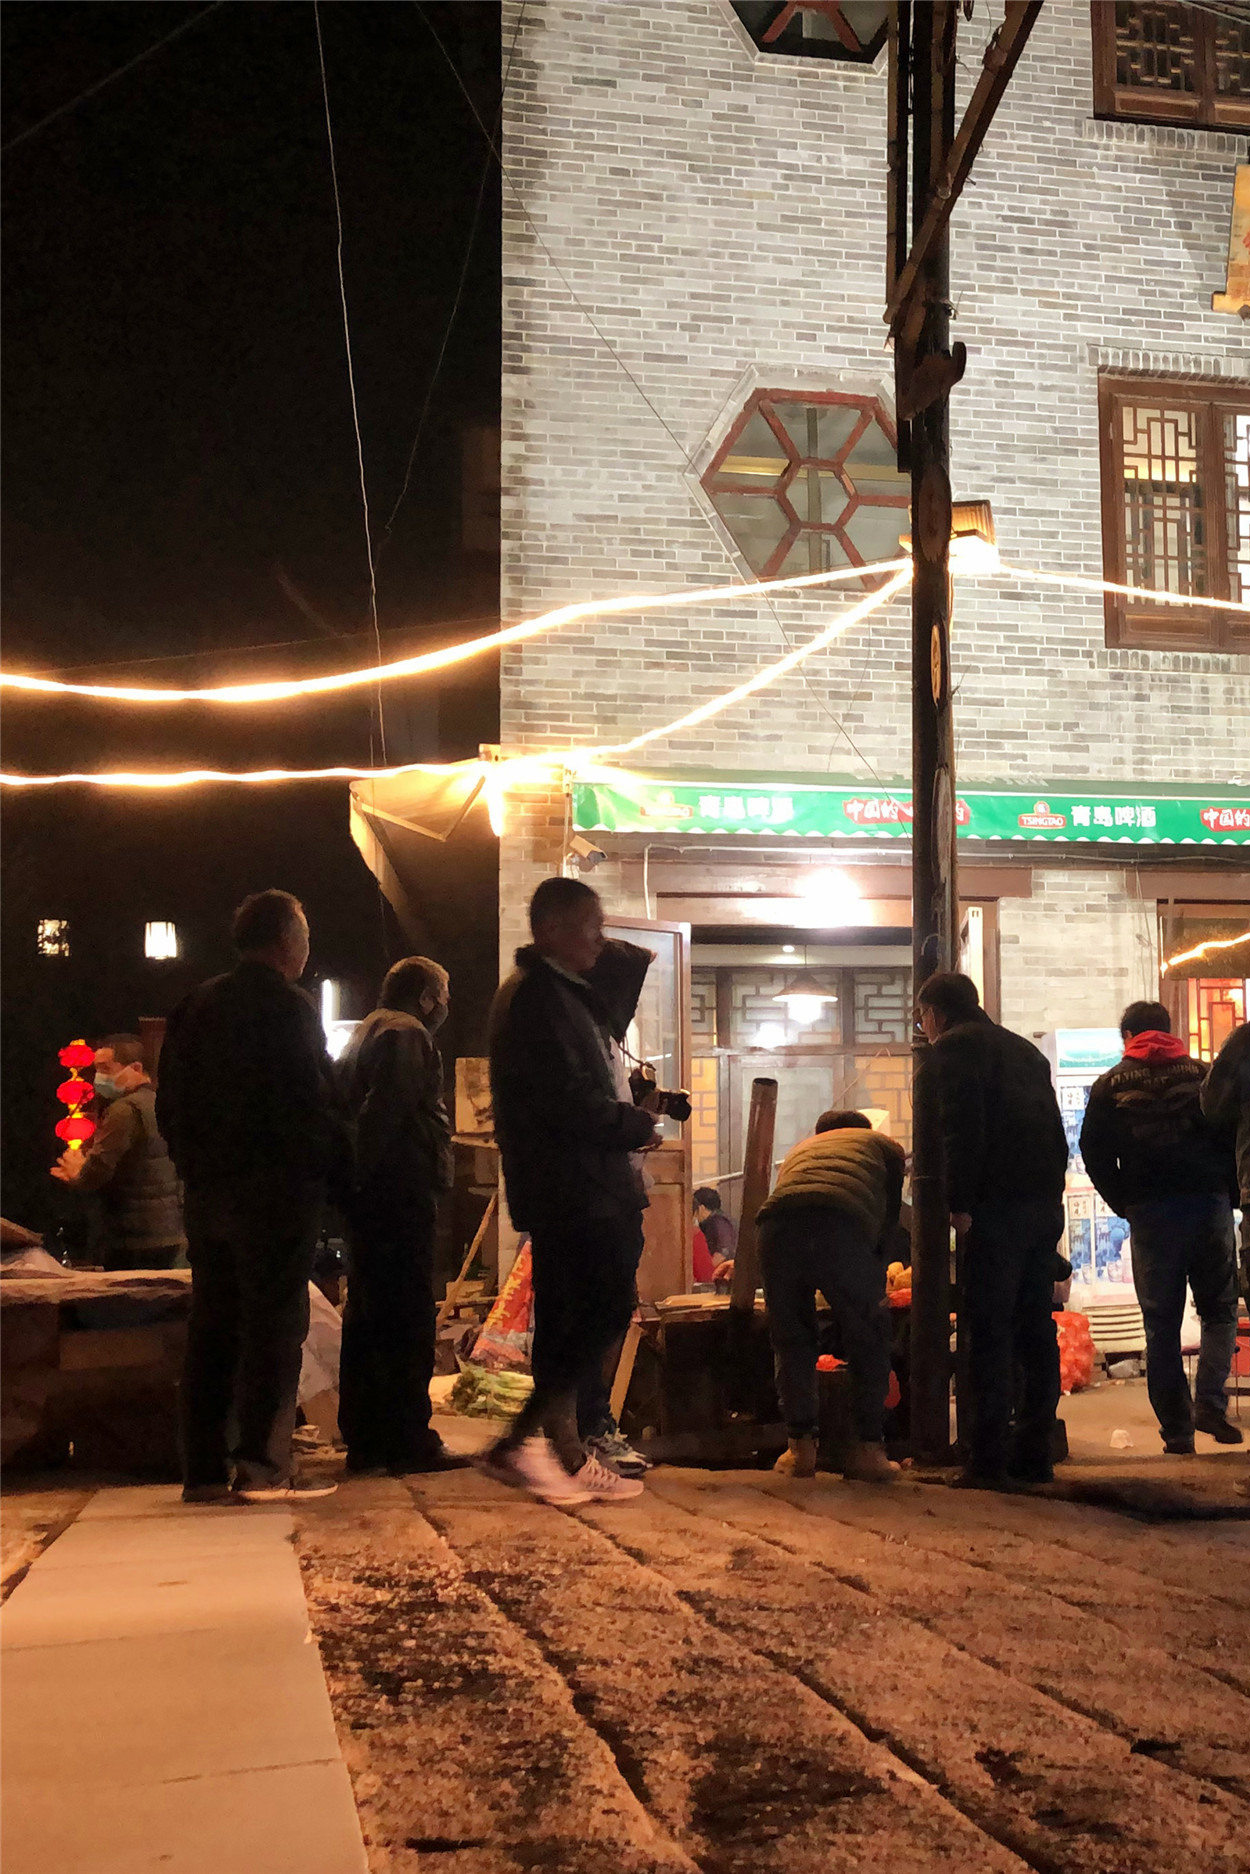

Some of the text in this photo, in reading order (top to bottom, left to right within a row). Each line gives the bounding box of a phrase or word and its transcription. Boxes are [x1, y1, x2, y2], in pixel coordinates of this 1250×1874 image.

[1021, 816, 1064, 826] TSINGTAO
[1203, 808, 1250, 829] 中国的
